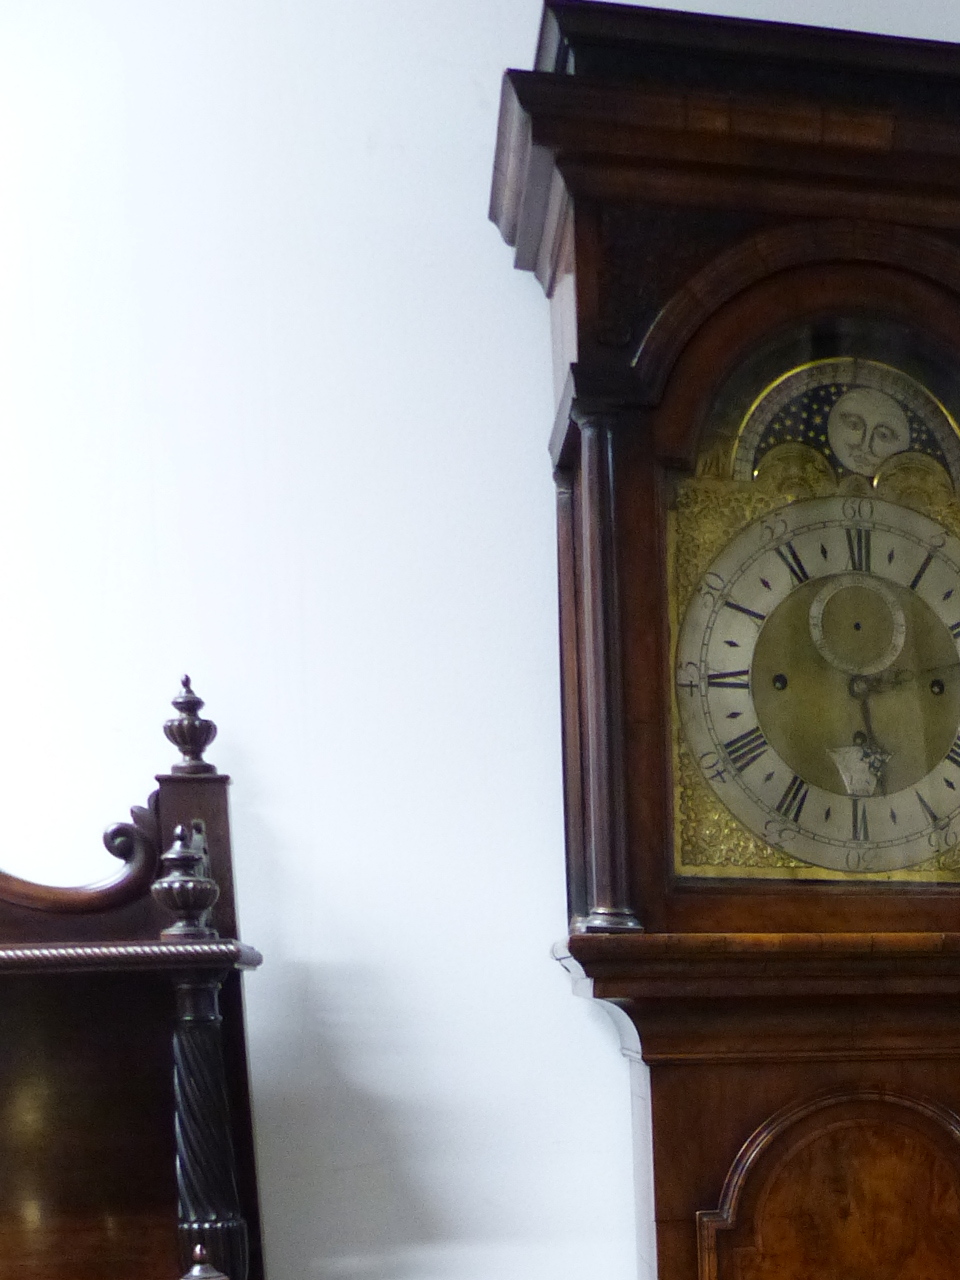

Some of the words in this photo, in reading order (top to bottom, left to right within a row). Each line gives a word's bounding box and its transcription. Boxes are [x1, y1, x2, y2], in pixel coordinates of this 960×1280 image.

[843, 501, 874, 520] 60
[774, 540, 809, 589] XI
[845, 527, 871, 573] XII
[699, 751, 727, 784] 40
